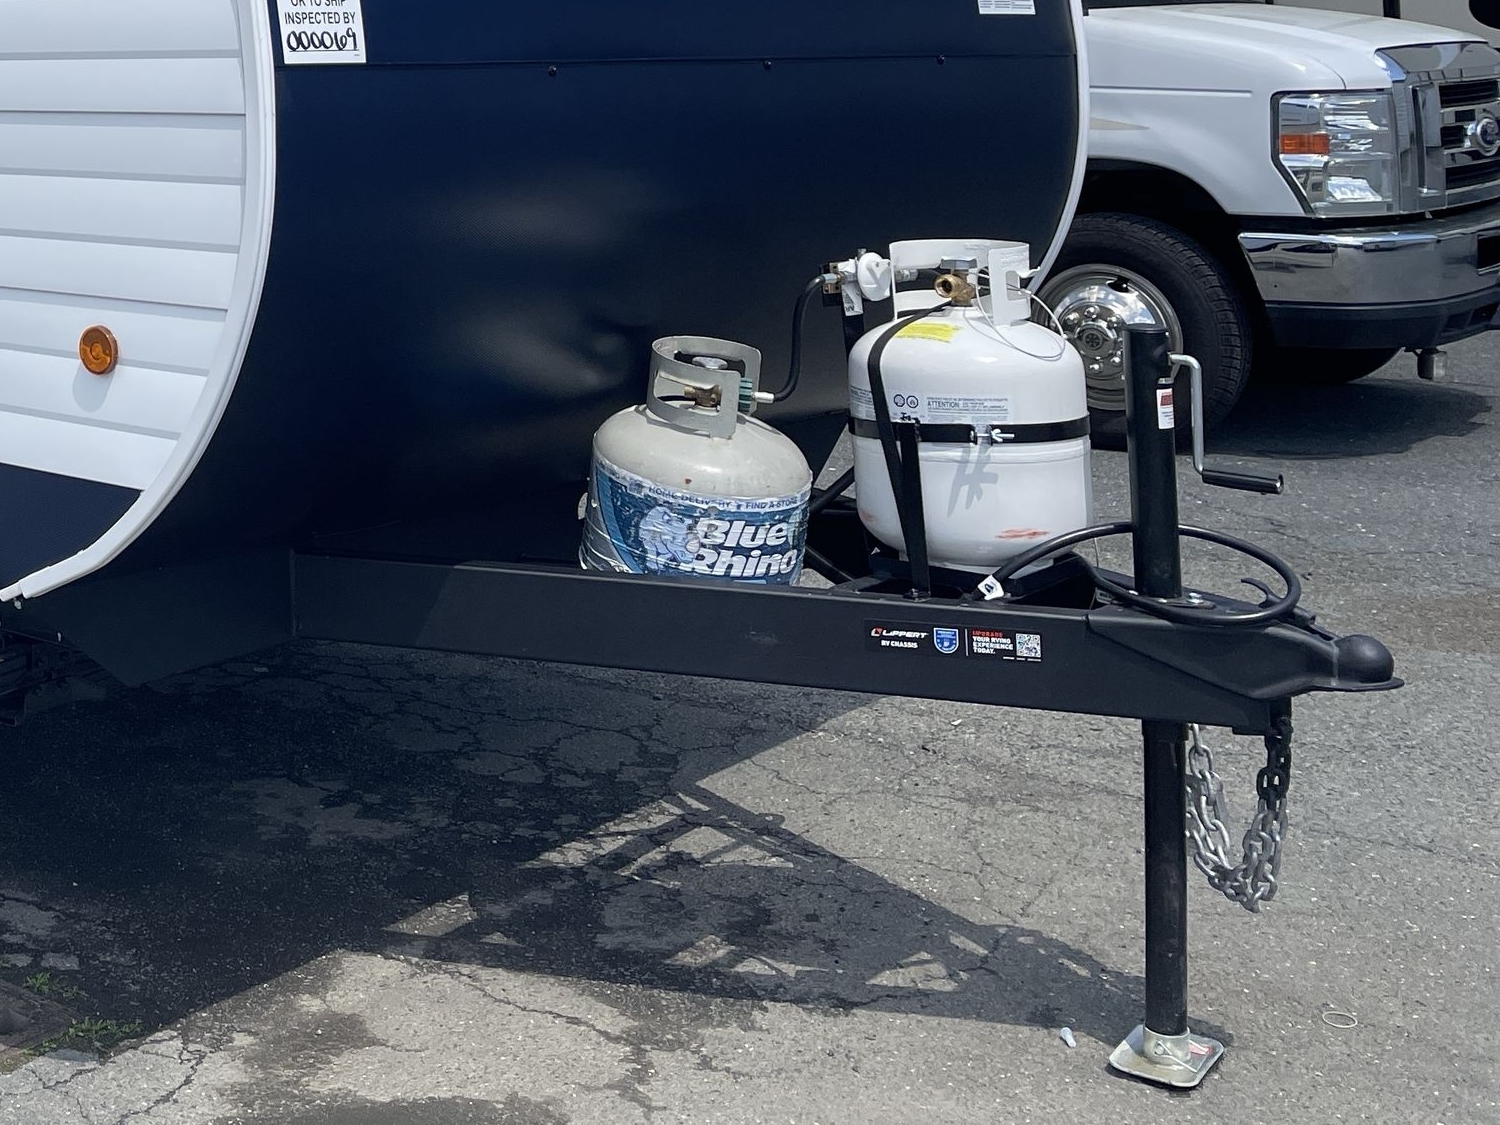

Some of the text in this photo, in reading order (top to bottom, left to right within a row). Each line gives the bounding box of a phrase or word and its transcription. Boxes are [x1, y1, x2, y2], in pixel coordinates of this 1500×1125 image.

[284, 11, 356, 25] INSPECTED BY
[745, 501, 768, 510] FIND
[696, 517, 789, 549] Blue
[689, 548, 798, 578] Rhino
[882, 629, 929, 639] LIPPERT
[891, 640, 918, 649] CHASSIS
[973, 642, 1013, 650] EXPERIENCE
